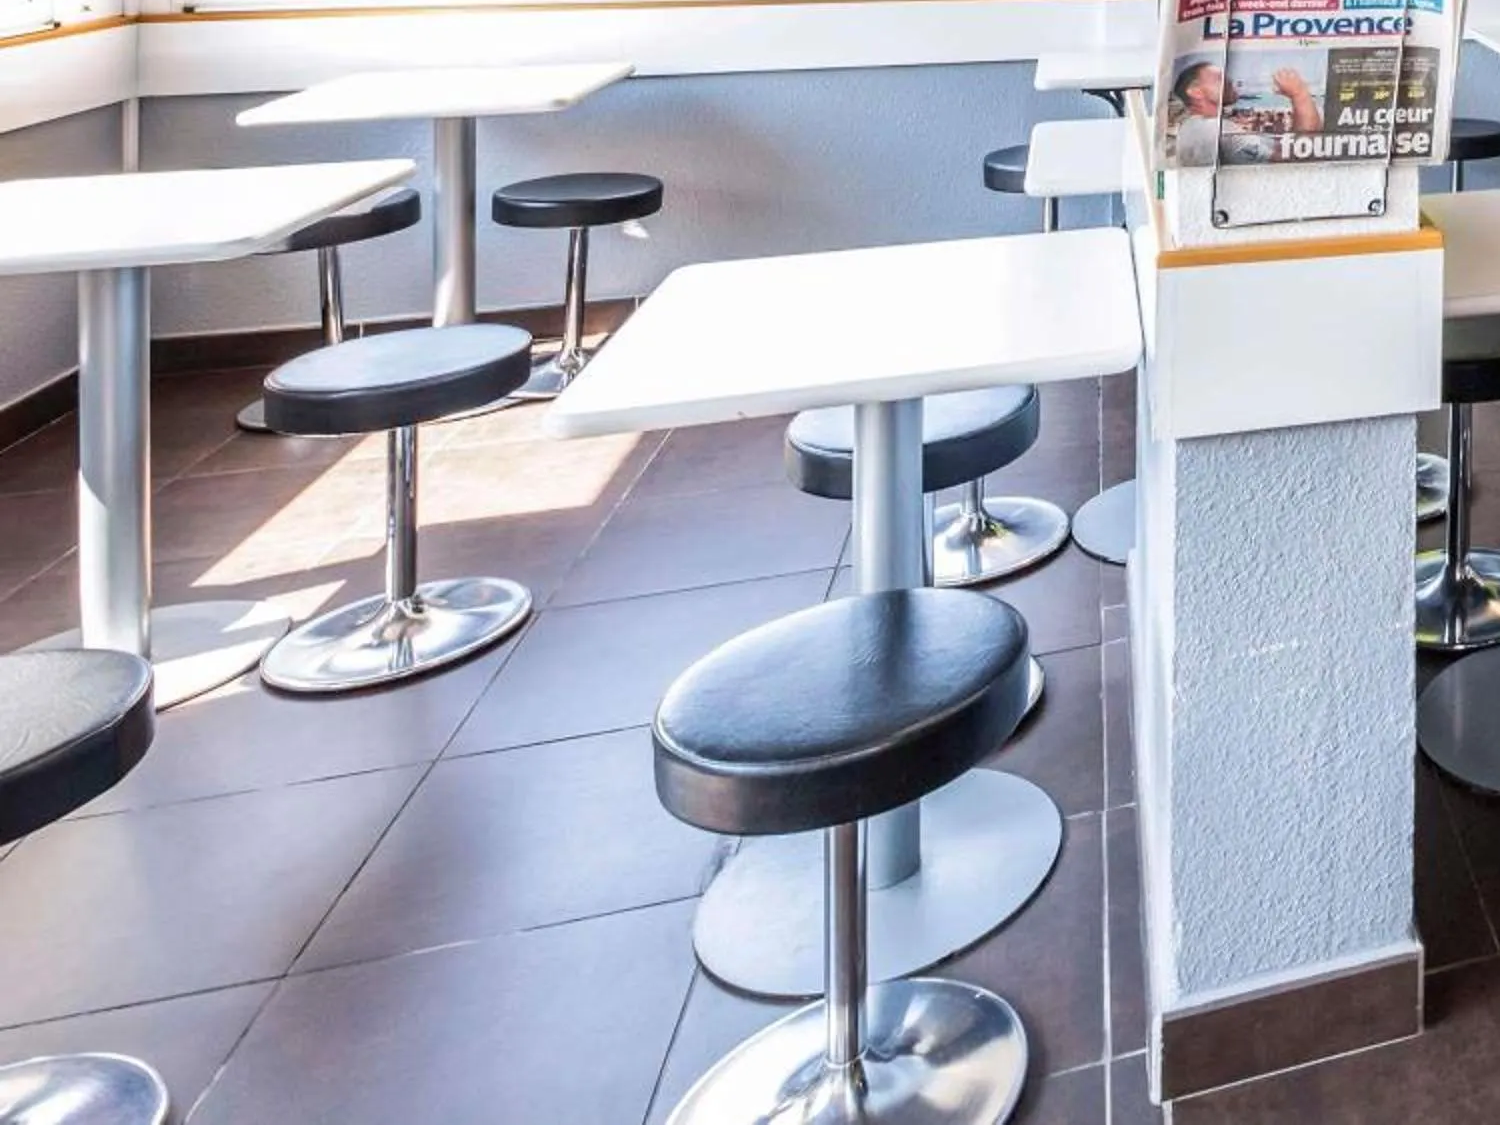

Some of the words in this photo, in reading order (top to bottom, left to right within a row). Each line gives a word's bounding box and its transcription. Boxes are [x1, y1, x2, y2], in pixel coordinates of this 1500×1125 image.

[1203, 16, 1246, 40] La
[1254, 13, 1414, 38] Provence
[1337, 106, 1370, 126] Au
[1279, 130, 1431, 159] fournase
